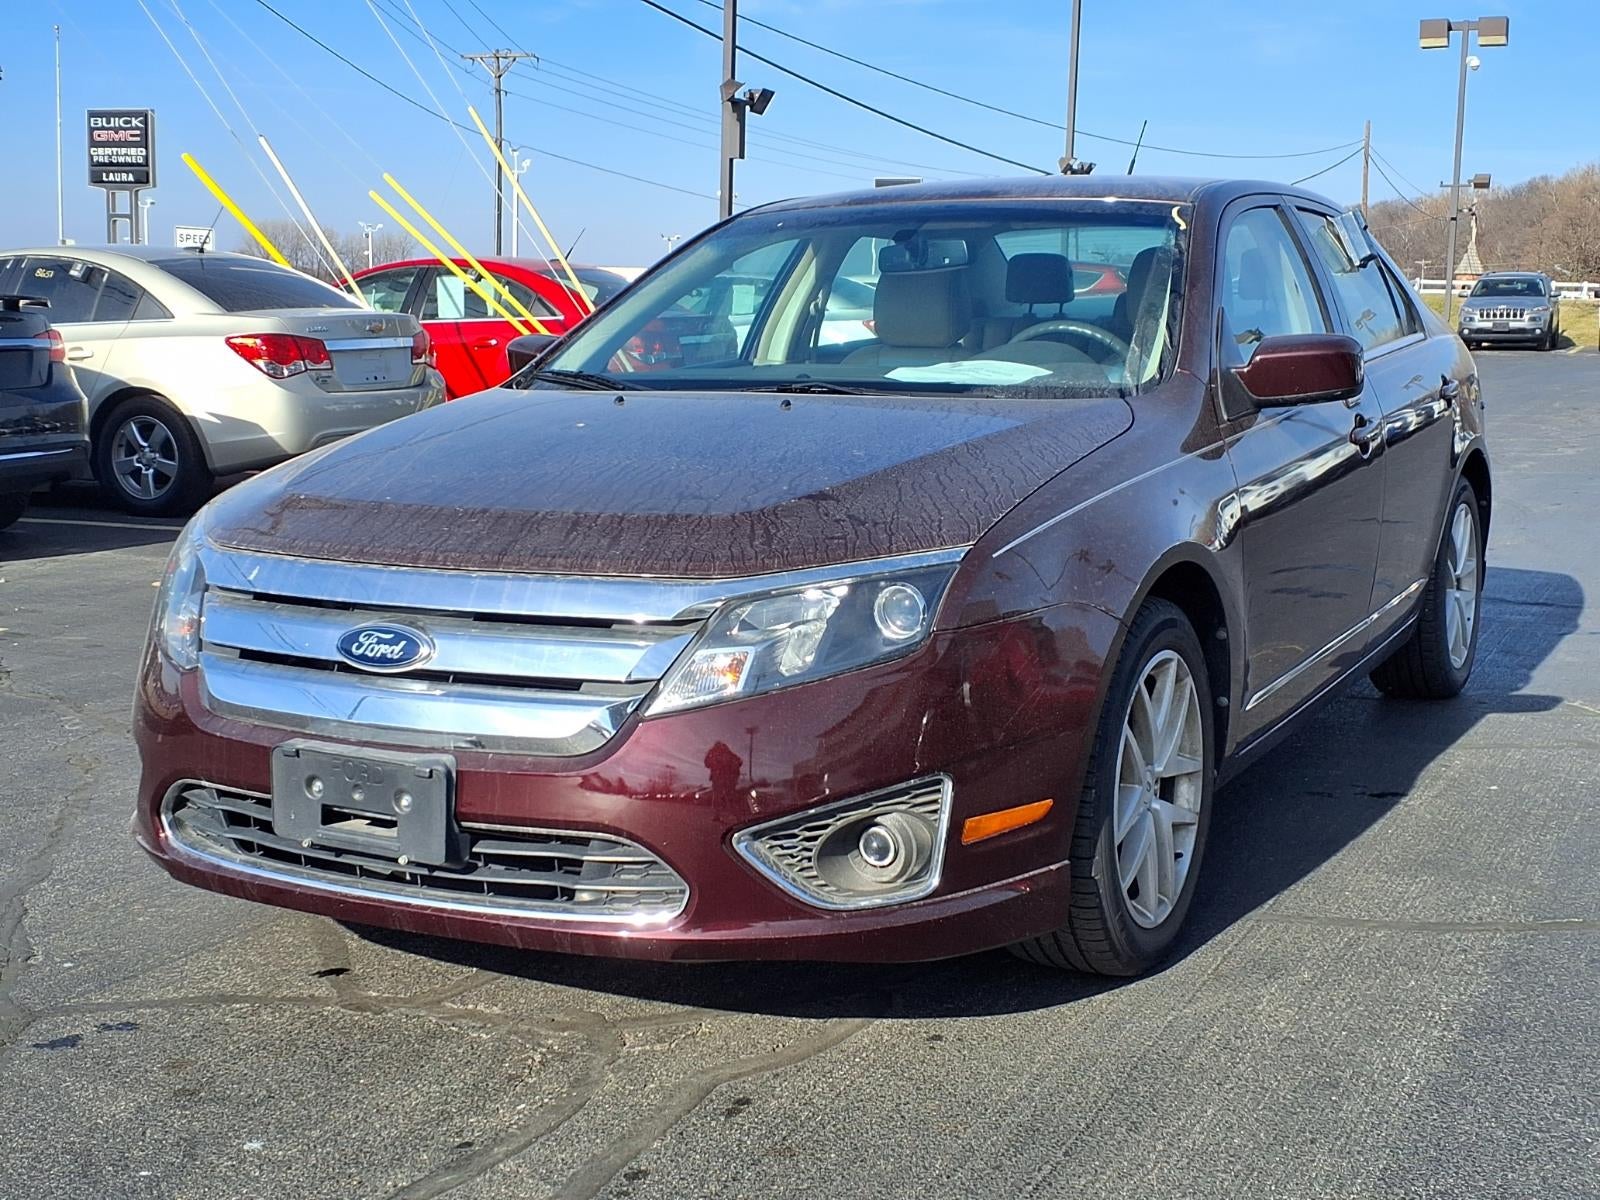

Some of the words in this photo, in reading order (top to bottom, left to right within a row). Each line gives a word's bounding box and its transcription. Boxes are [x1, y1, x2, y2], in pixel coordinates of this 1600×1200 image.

[90, 117, 144, 127] BUICK
[93, 130, 141, 141] GMC
[90, 147, 146, 155] CERTIFIED
[102, 172, 134, 182] LAURA
[352, 631, 407, 659] Ford
